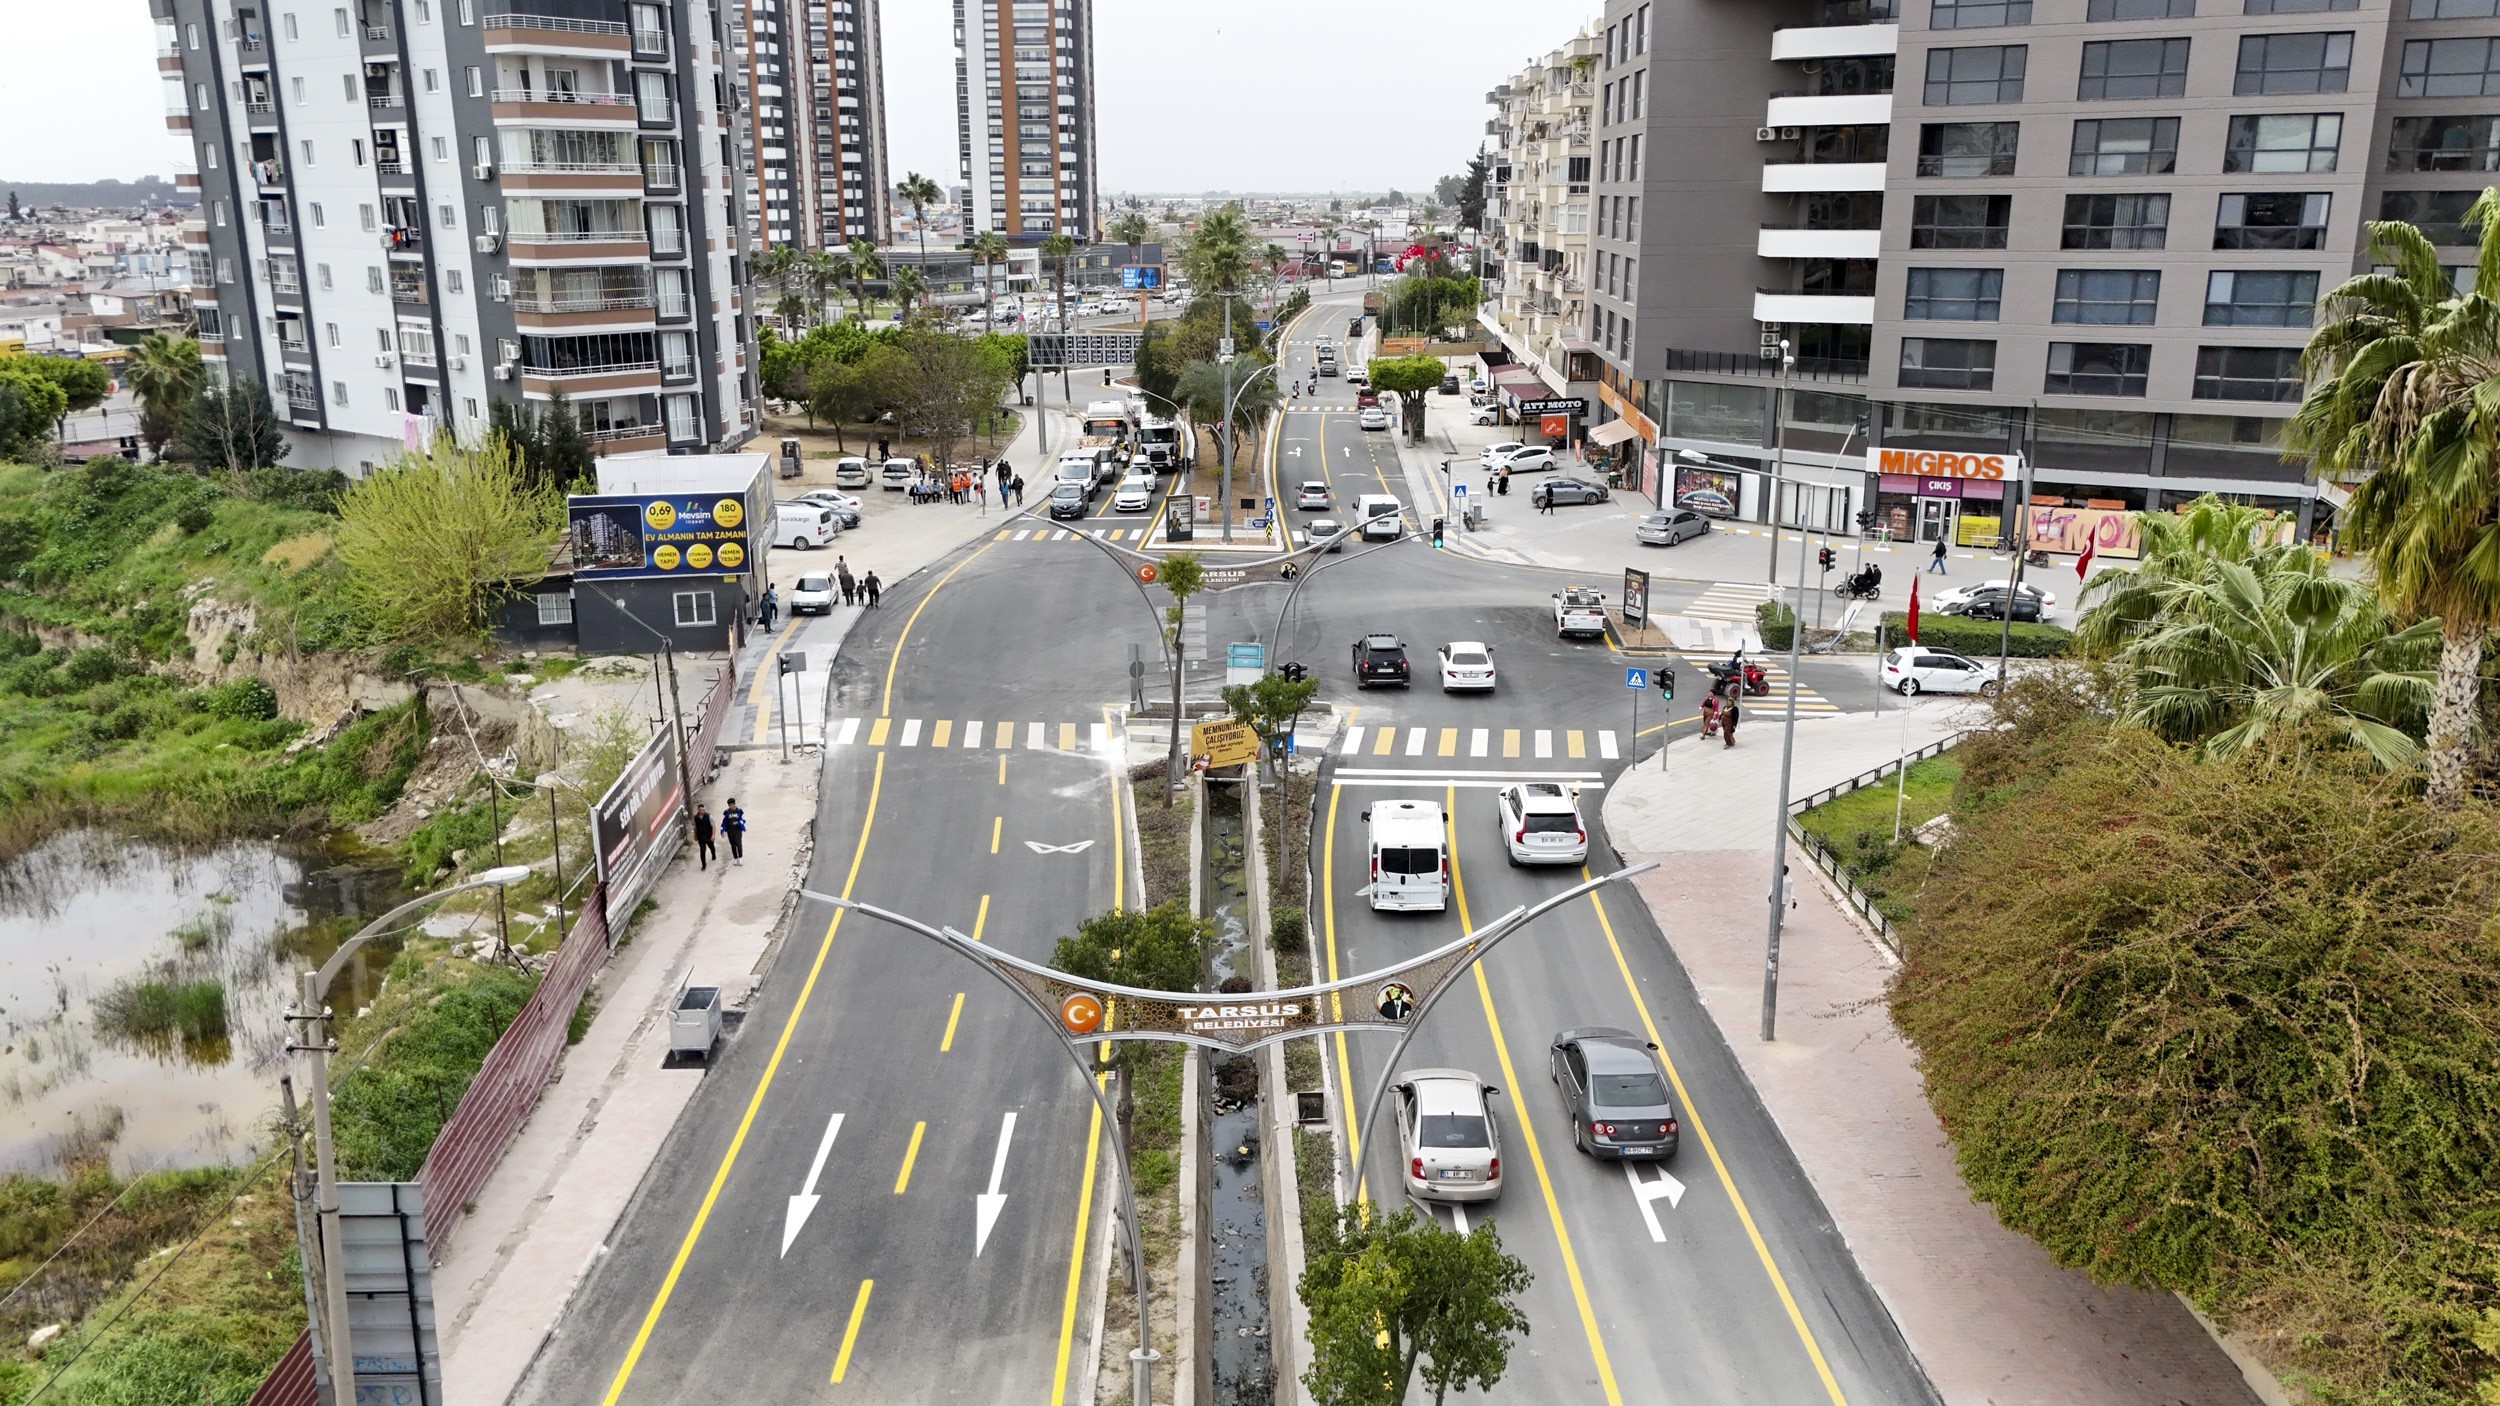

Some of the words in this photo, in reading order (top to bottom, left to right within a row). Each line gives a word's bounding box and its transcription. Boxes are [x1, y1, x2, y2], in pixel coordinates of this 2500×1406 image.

[1523, 402, 1545, 410] AYT
[1547, 400, 1582, 409] MOTO
[1928, 481, 1952, 492] ÇIKIŞ
[649, 505, 671, 517] 0,69
[720, 504, 735, 512] 180
[678, 511, 711, 519] Mevsim
[657, 532, 695, 541] ALMANIN
[696, 532, 713, 540] TAM
[715, 530, 747, 539] ZAMANI
[1205, 730, 1246, 745] ÇALIŞIYORUZ.
[1177, 1004, 1300, 1019] TARSUS
[1193, 1017, 1285, 1030] BELEDİYESİ
